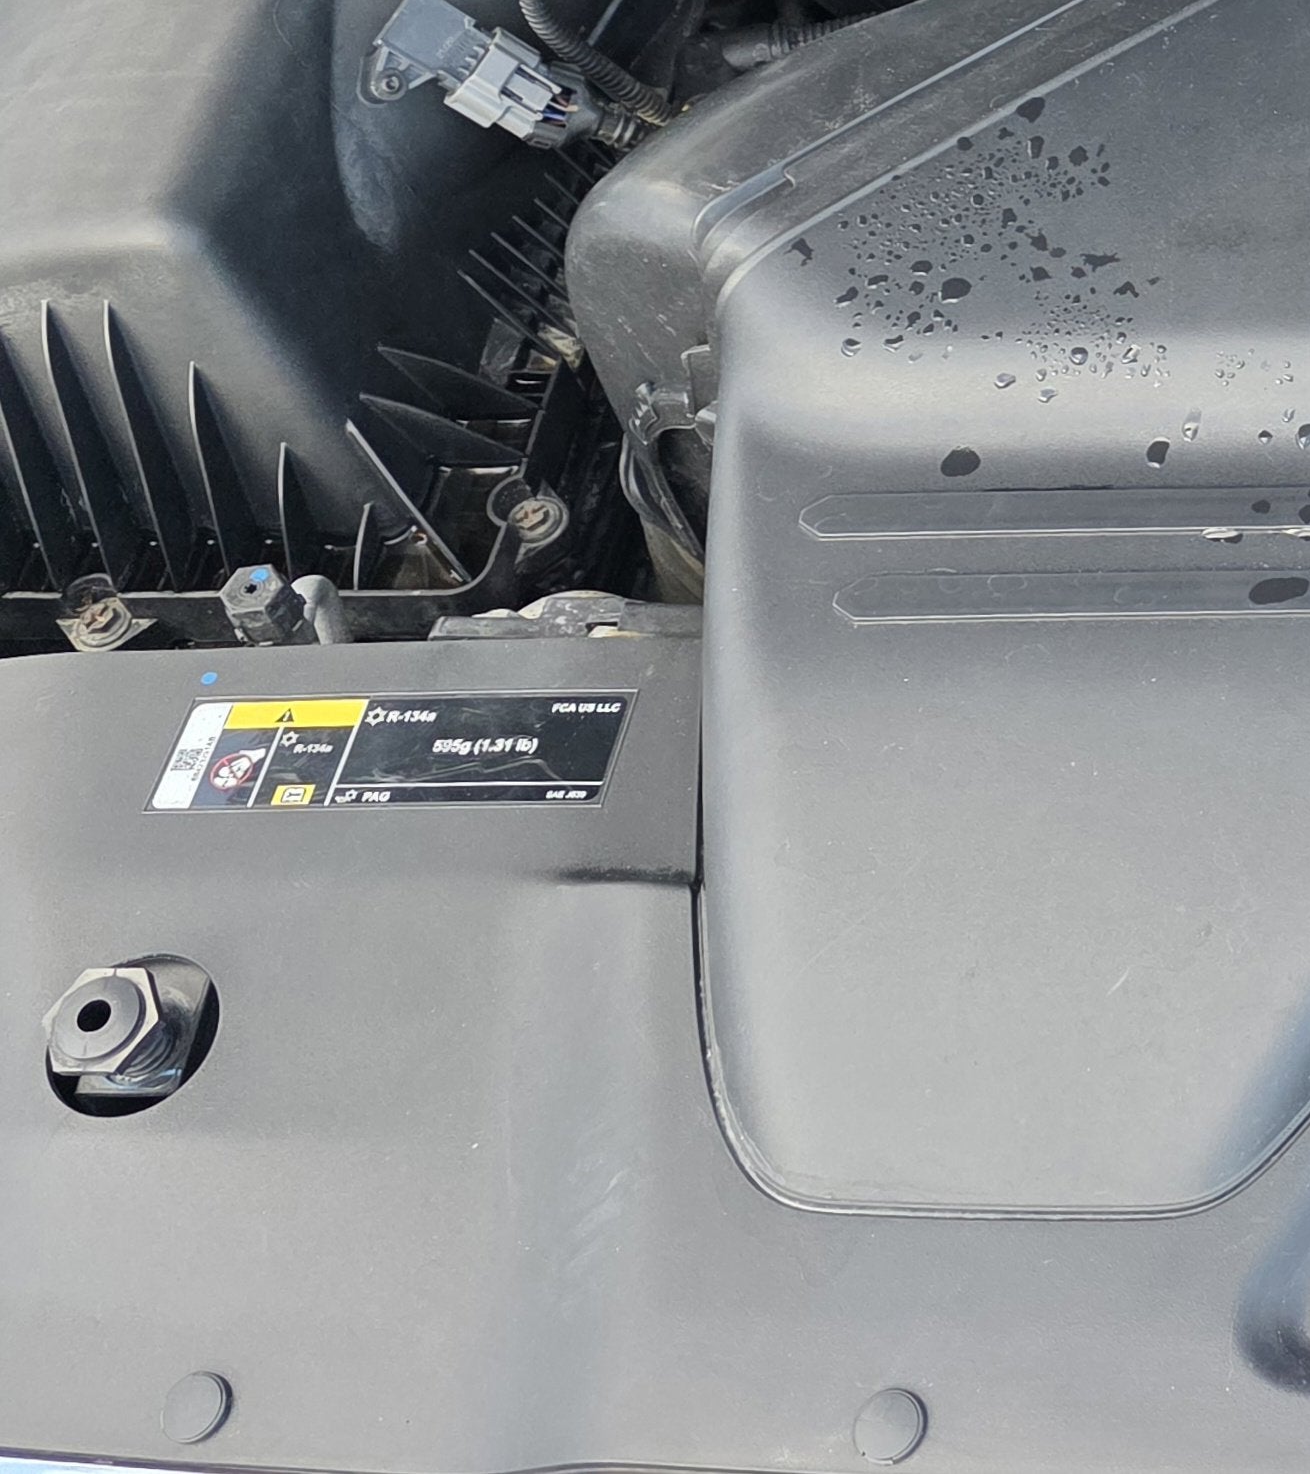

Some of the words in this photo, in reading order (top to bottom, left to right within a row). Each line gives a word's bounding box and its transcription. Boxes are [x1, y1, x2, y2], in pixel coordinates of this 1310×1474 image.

[551, 702, 577, 713] FCA
[596, 702, 622, 713] LLC
[385, 709, 438, 724] R-134a
[431, 738, 474, 756] 595g
[361, 790, 391, 803] PAG
